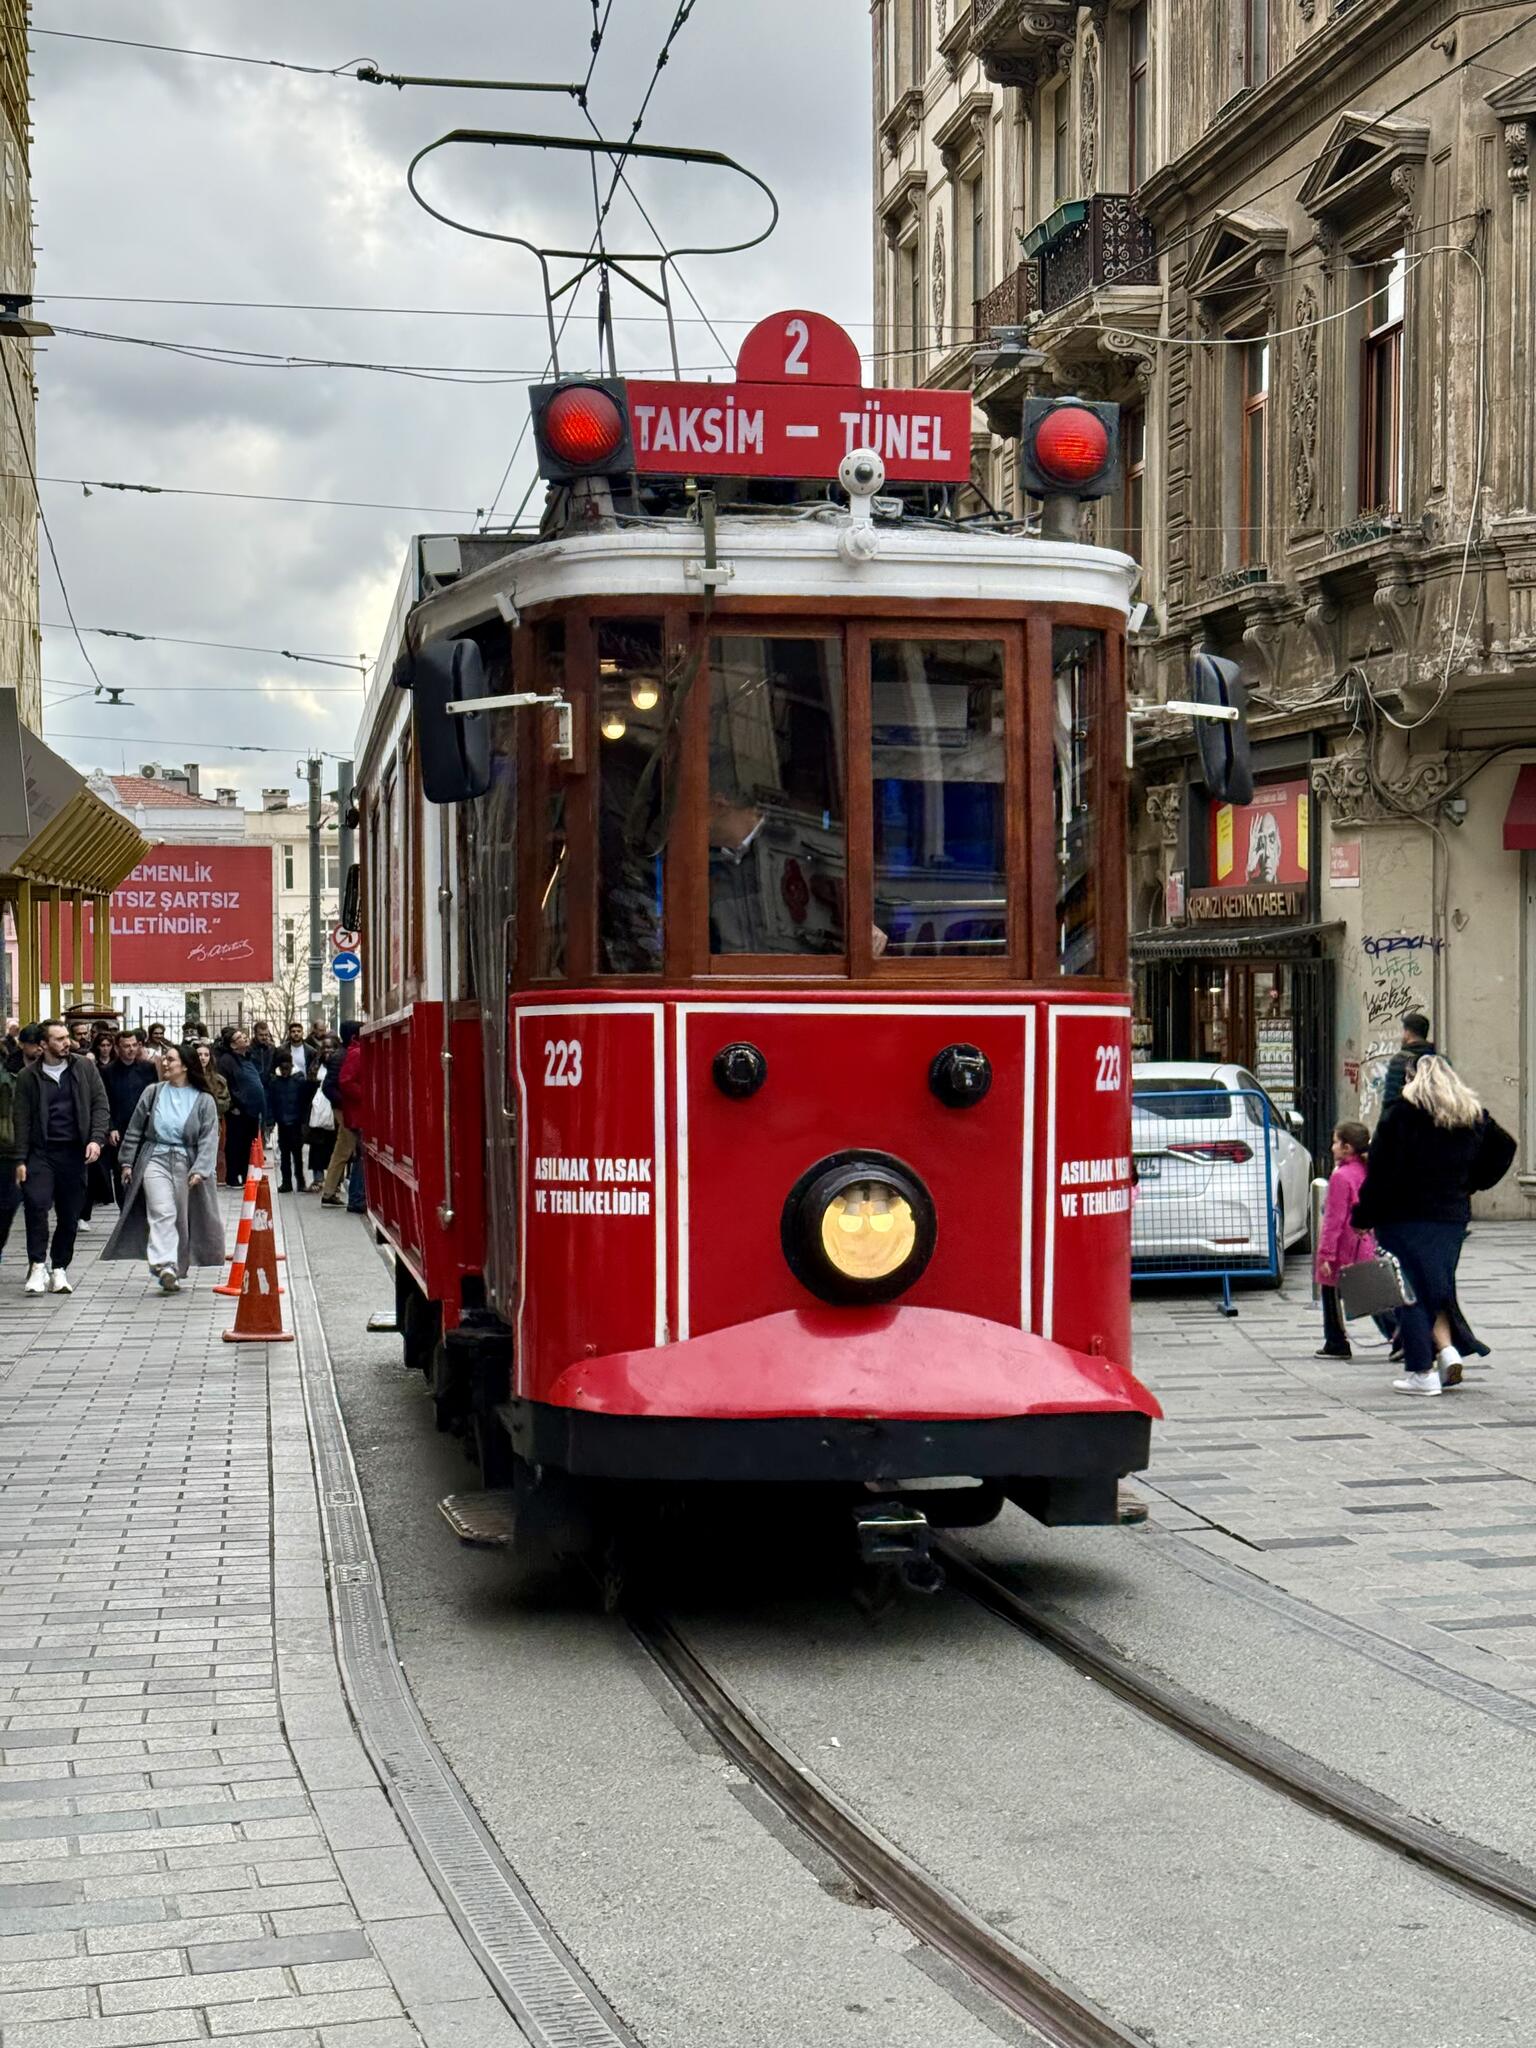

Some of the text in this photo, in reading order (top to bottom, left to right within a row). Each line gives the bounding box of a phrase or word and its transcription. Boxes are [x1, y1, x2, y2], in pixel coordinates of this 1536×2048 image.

[785, 319, 809, 375] 2
[634, 395, 764, 455] TAKSİM
[839, 400, 951, 461] TÜNEL
[124, 861, 213, 883] EMENLİK
[161, 891, 240, 911] ŞARTSIZ
[544, 1039, 582, 1087] 223
[1095, 1045, 1121, 1091] 223
[535, 1157, 651, 1182] ASILMAK YASAK
[1061, 1158, 1114, 1186] ASILMAK
[535, 1187, 650, 1216] VE TEHLİKELİDİR
[1061, 1193, 1078, 1217] VE
